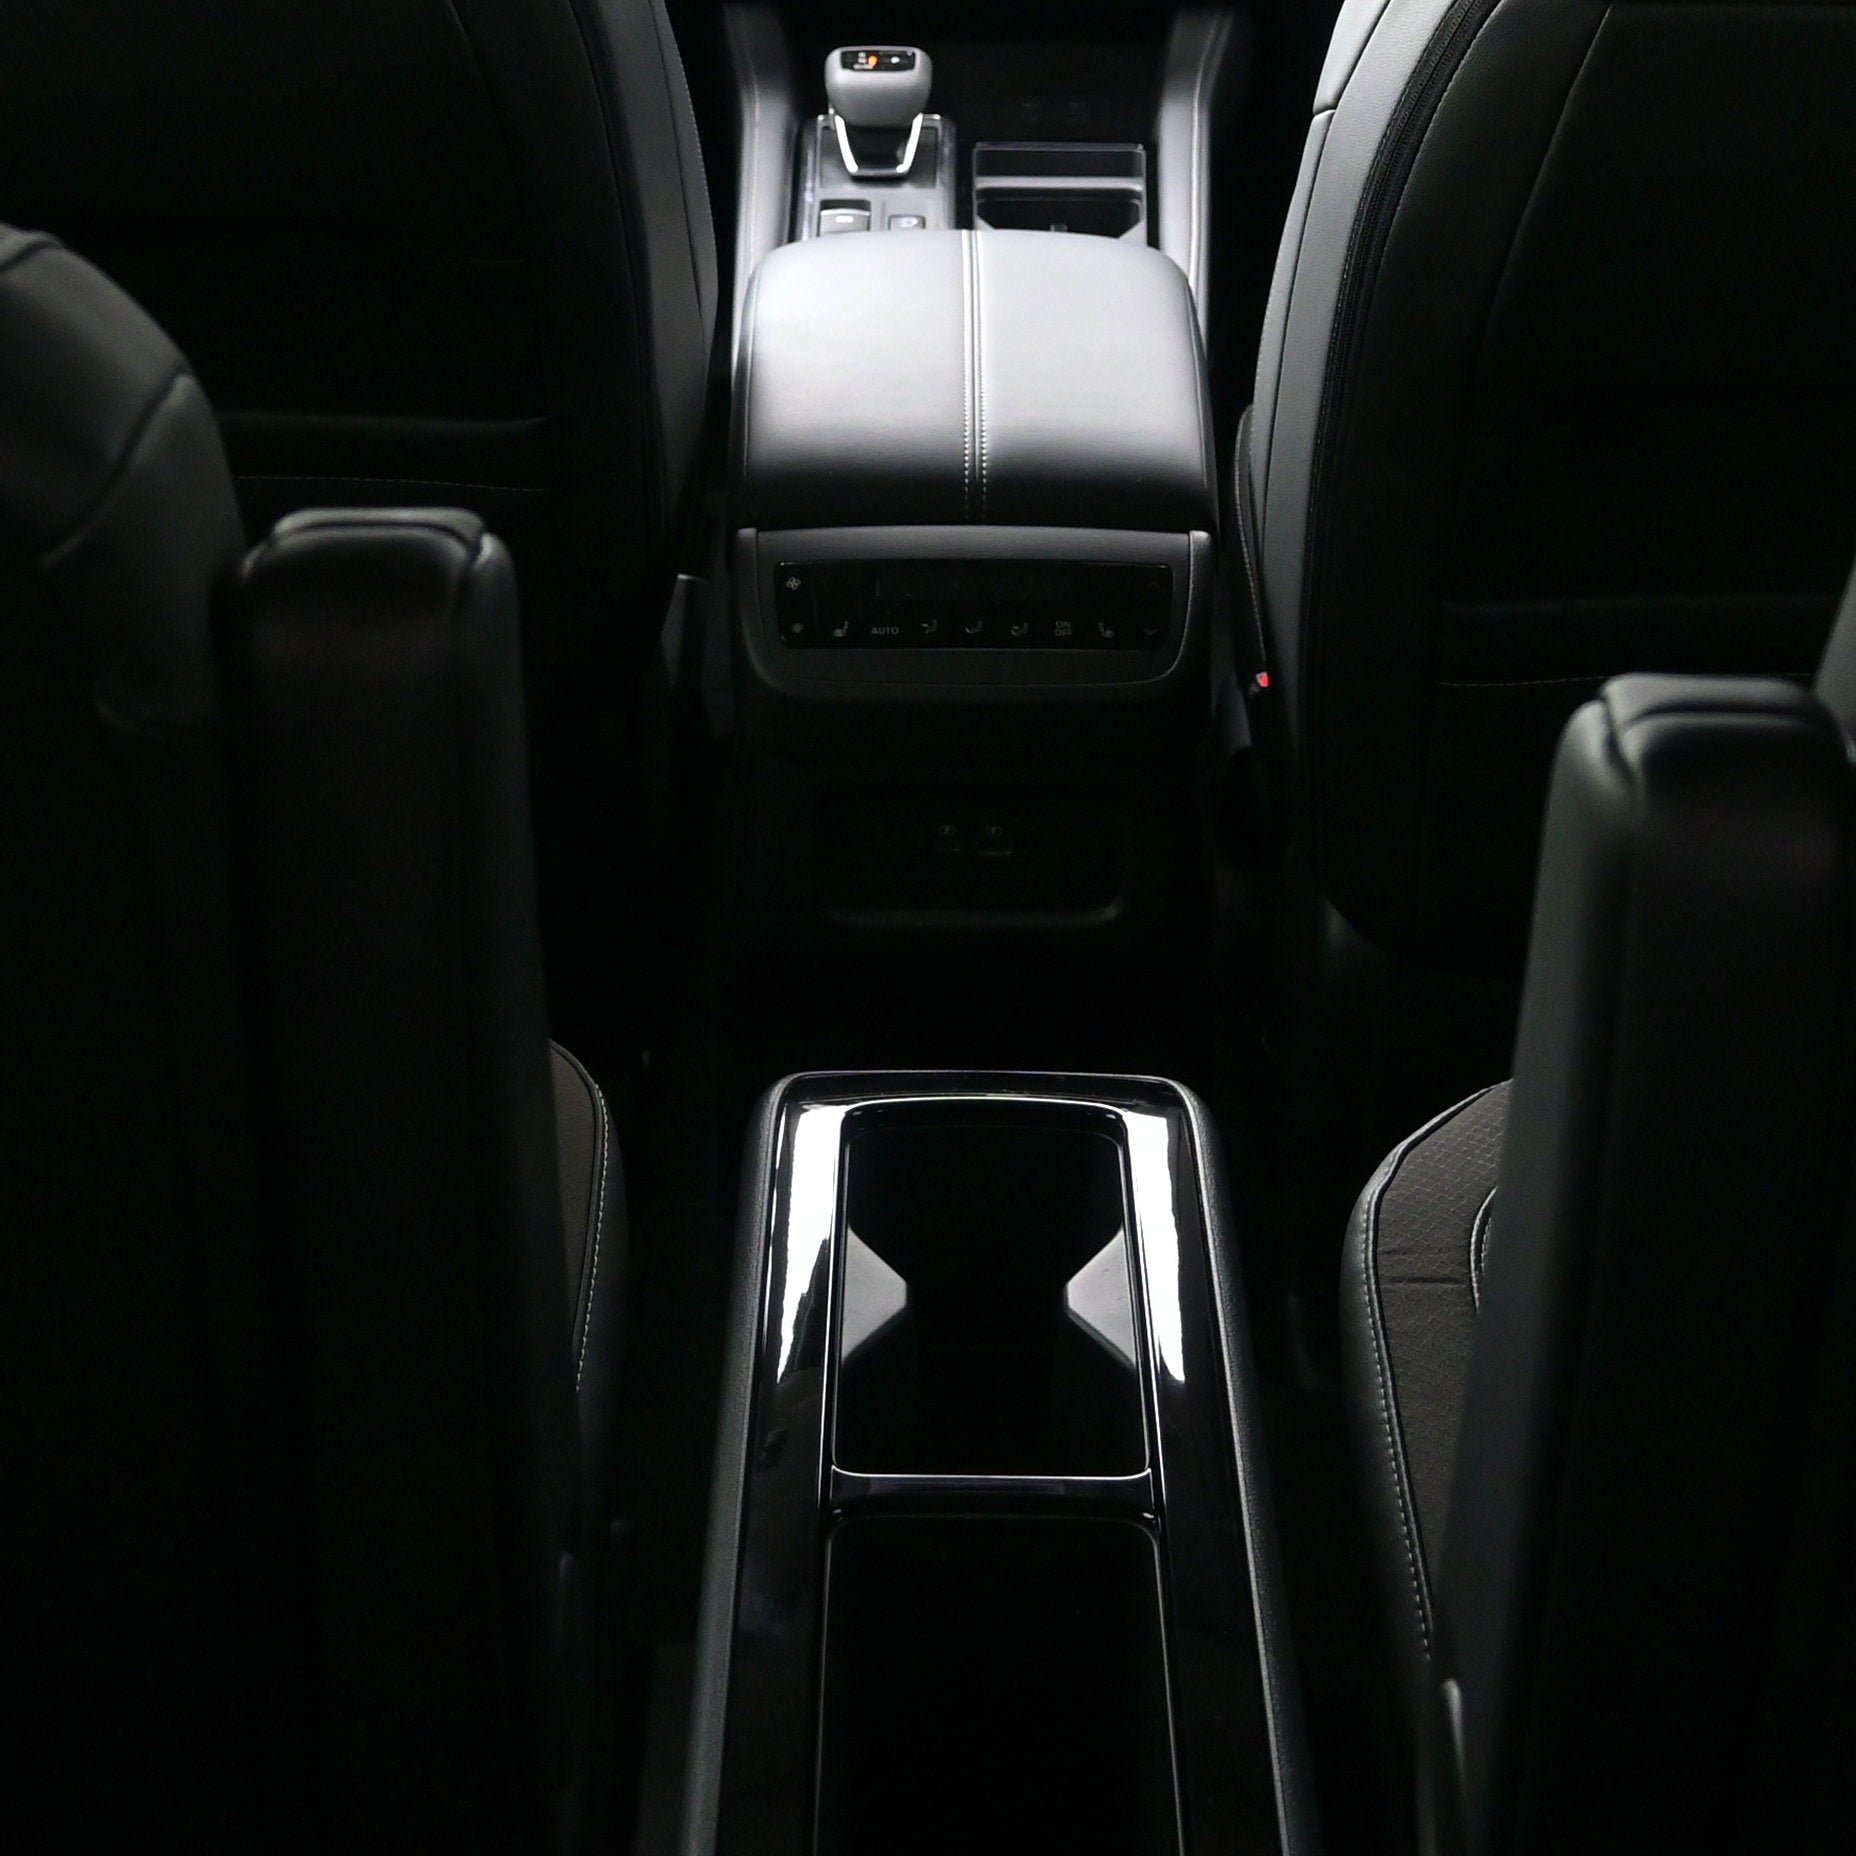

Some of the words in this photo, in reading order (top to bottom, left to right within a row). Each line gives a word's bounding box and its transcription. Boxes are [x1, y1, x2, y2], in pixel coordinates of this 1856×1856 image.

[1055, 619, 1072, 628] ON
[870, 626, 900, 637] AUTO
[1054, 628, 1073, 637] OFF
